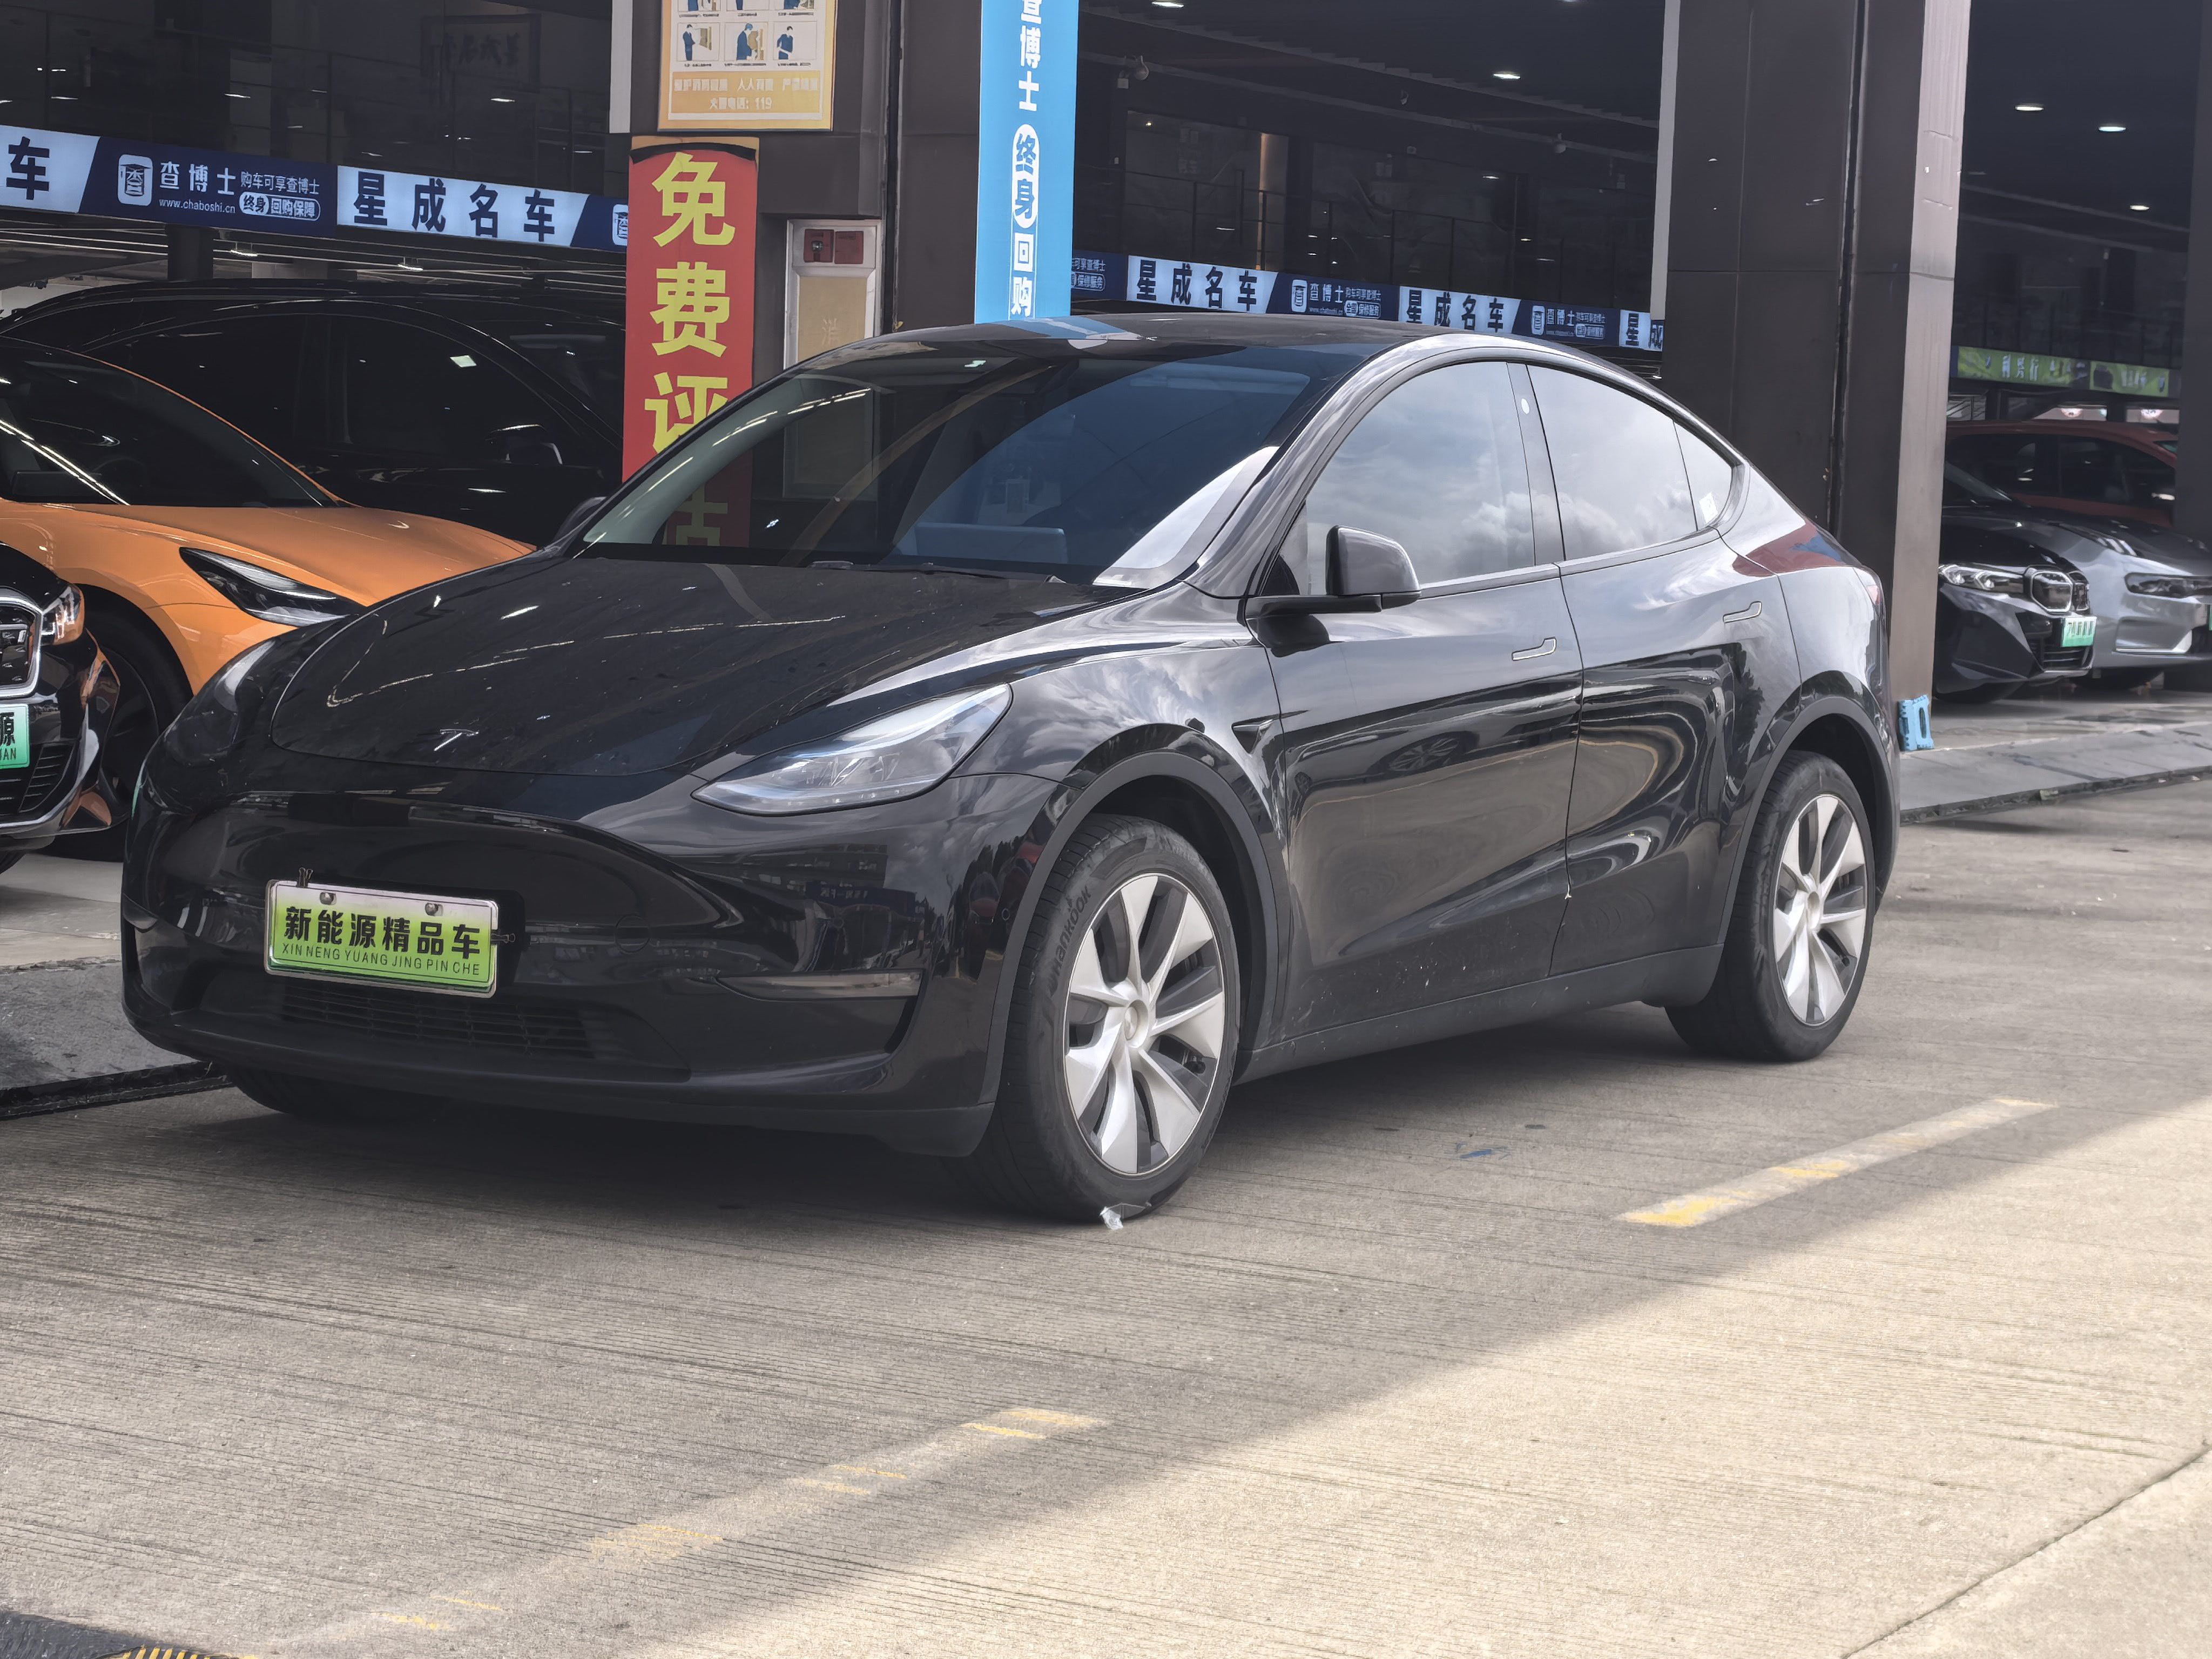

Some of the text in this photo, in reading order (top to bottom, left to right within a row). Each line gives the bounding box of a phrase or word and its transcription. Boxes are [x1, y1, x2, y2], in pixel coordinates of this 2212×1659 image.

[6, 136, 50, 200] 车
[159, 161, 236, 195] 查博士
[240, 171, 320, 195] 购车可享查博士
[159, 198, 236, 214] www.chaboshi.cn
[353, 171, 555, 242] 星成名车
[1137, 259, 1257, 312] 星成名车
[1406, 289, 1505, 333] 星成名车
[285, 906, 481, 960] 新能源精品车
[282, 943, 481, 976] XIN NENG YUANG JING PIN CHE
